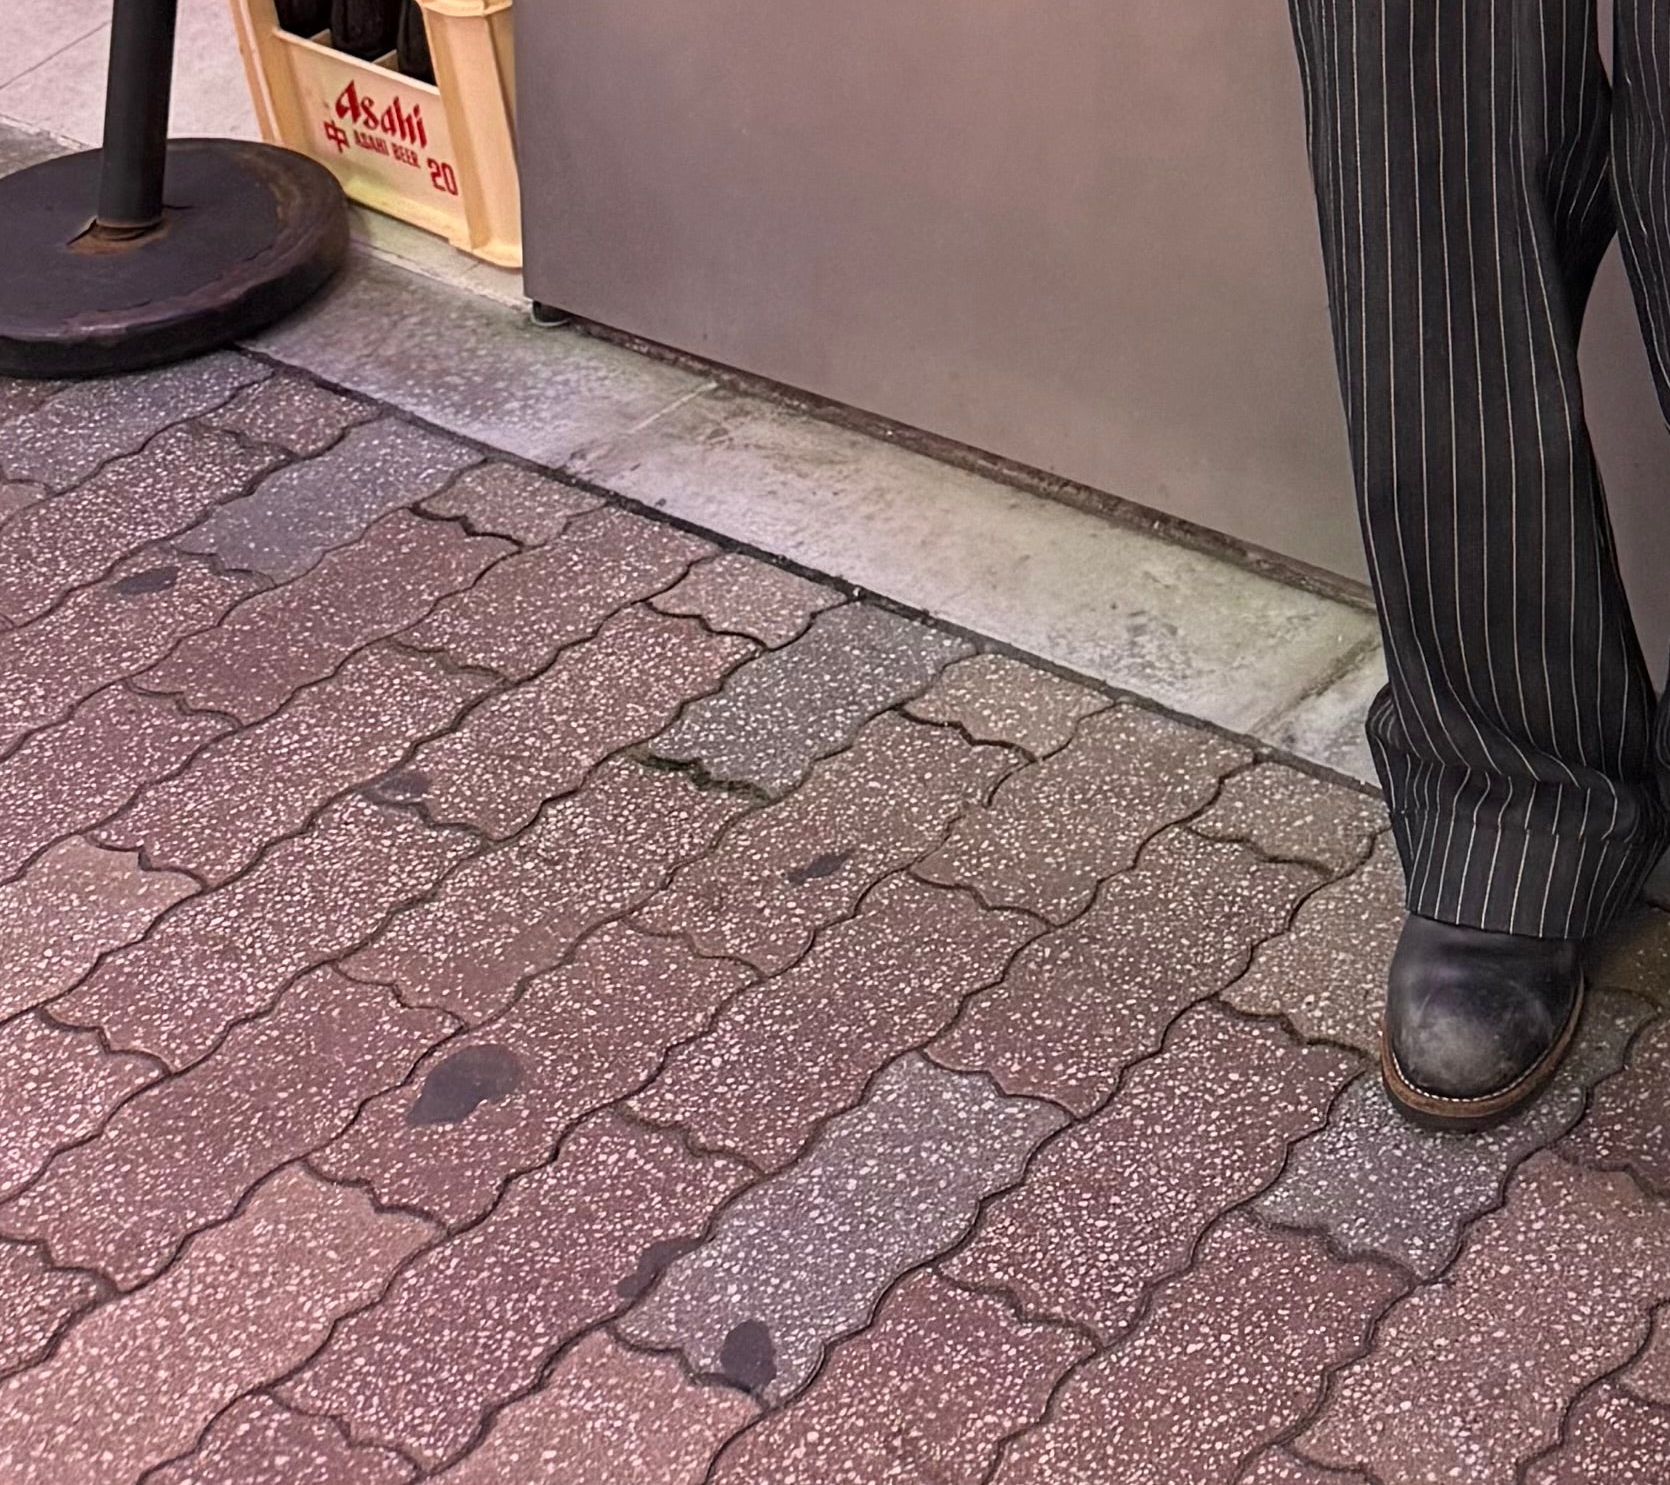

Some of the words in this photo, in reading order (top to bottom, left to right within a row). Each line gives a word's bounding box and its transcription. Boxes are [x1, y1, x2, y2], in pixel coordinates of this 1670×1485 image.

[335, 79, 427, 149] Asahi
[354, 130, 389, 158] ASAHI
[392, 145, 421, 169] BEER
[427, 158, 459, 196] 20
